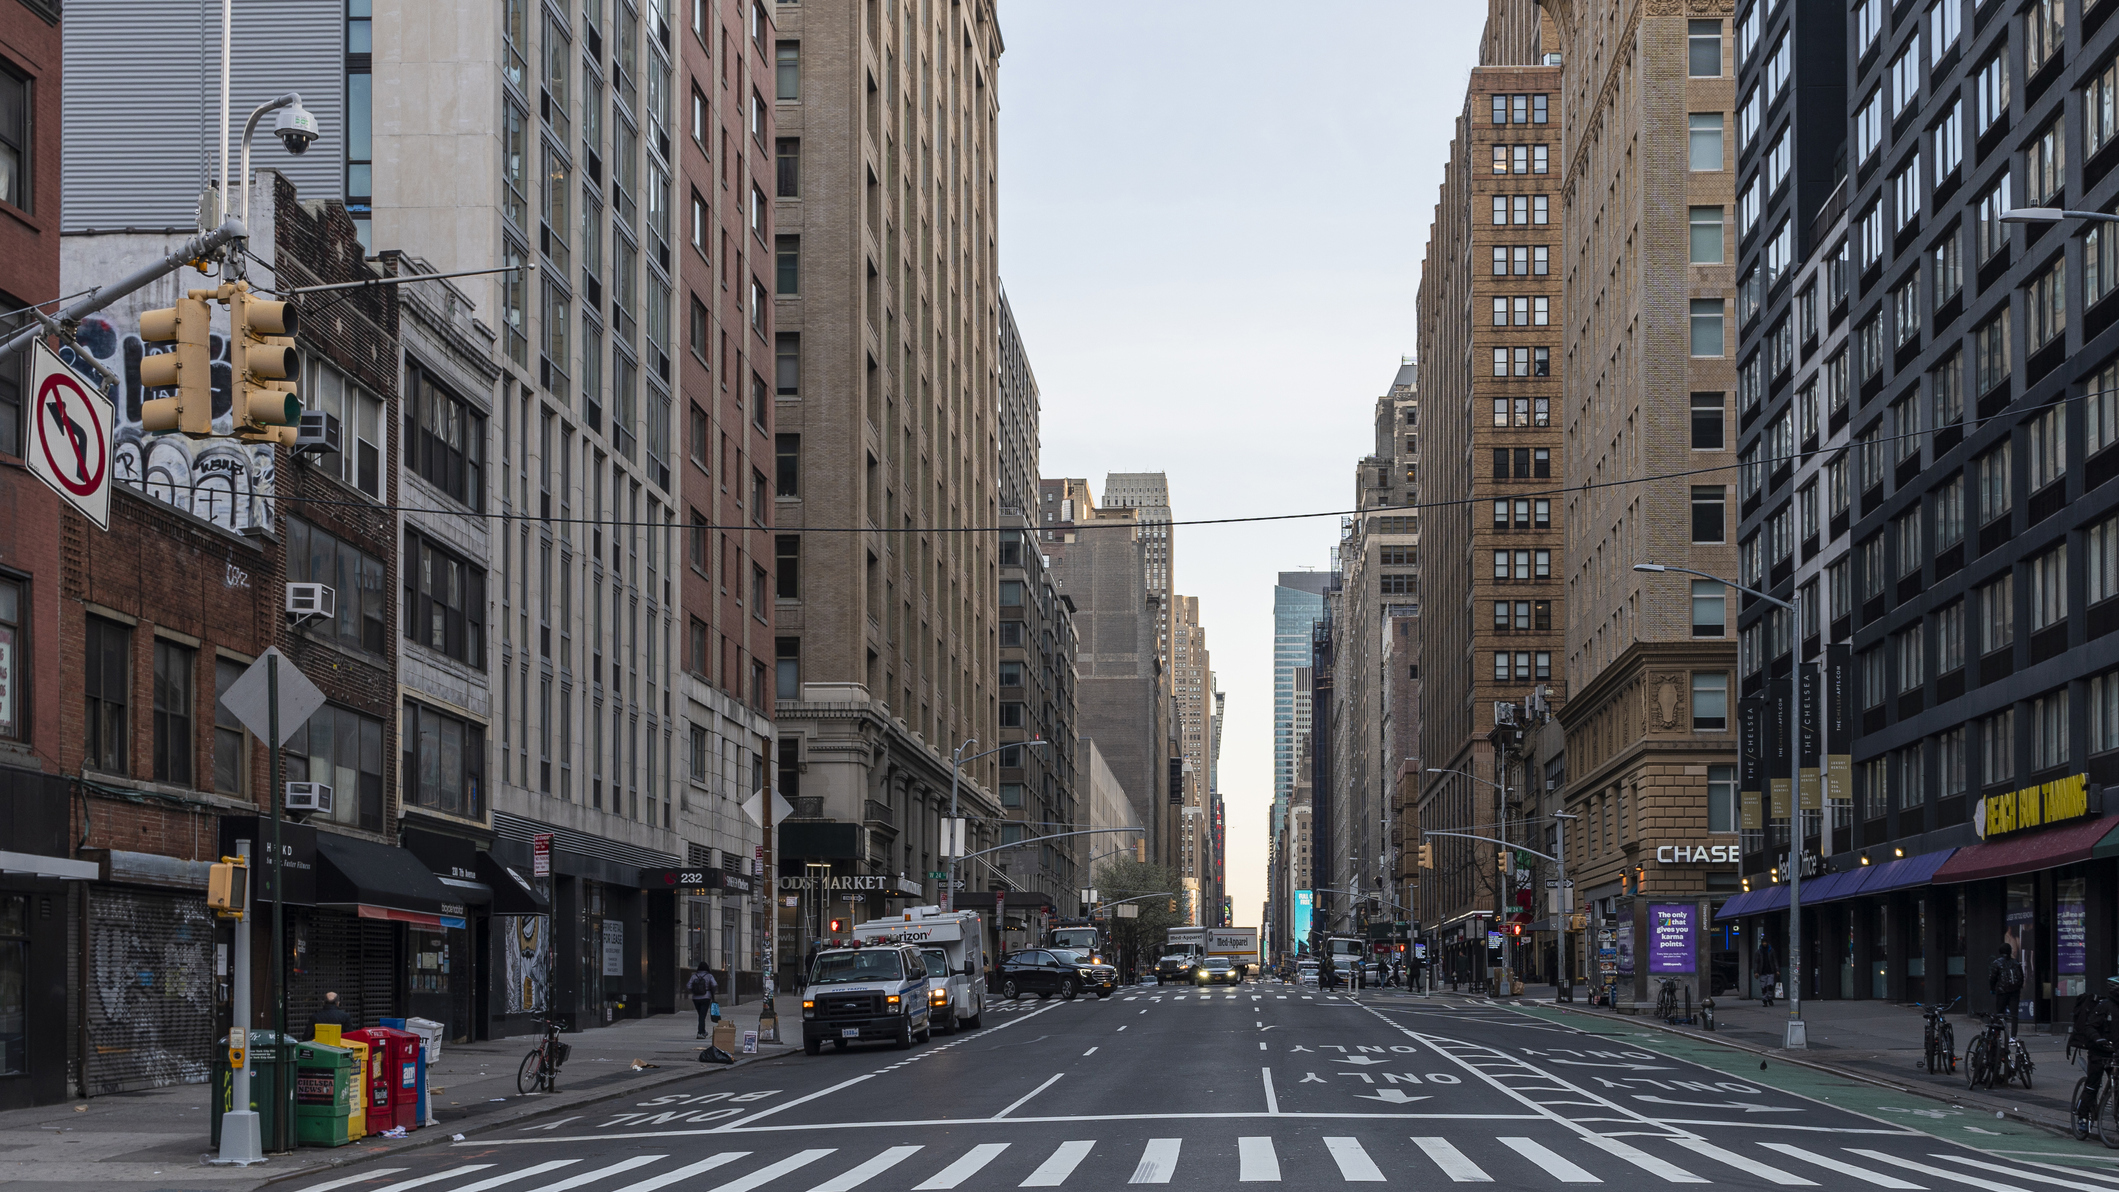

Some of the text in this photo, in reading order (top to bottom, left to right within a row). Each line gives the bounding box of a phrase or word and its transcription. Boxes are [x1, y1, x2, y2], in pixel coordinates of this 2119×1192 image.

[1987, 772, 2087, 836] BEACH BUM TANNING
[266, 842, 292, 856] HKD
[1657, 846, 1739, 863] CHASE
[1779, 852, 1791, 882] Fed
[681, 873, 703, 883] 232
[779, 876, 811, 890] ODS
[611, 933, 622, 945] LEASE
[898, 931, 927, 940] rizon
[1217, 937, 1248, 949] Med-Apparel
[419, 1036, 429, 1045] RIT
[1519, 1048, 1656, 1060] ONLY
[1299, 1072, 1462, 1084] ONLY
[1591, 1077, 1762, 1094] ONLY
[636, 1090, 784, 1106] BUS
[520, 1108, 745, 1131] ONLY
